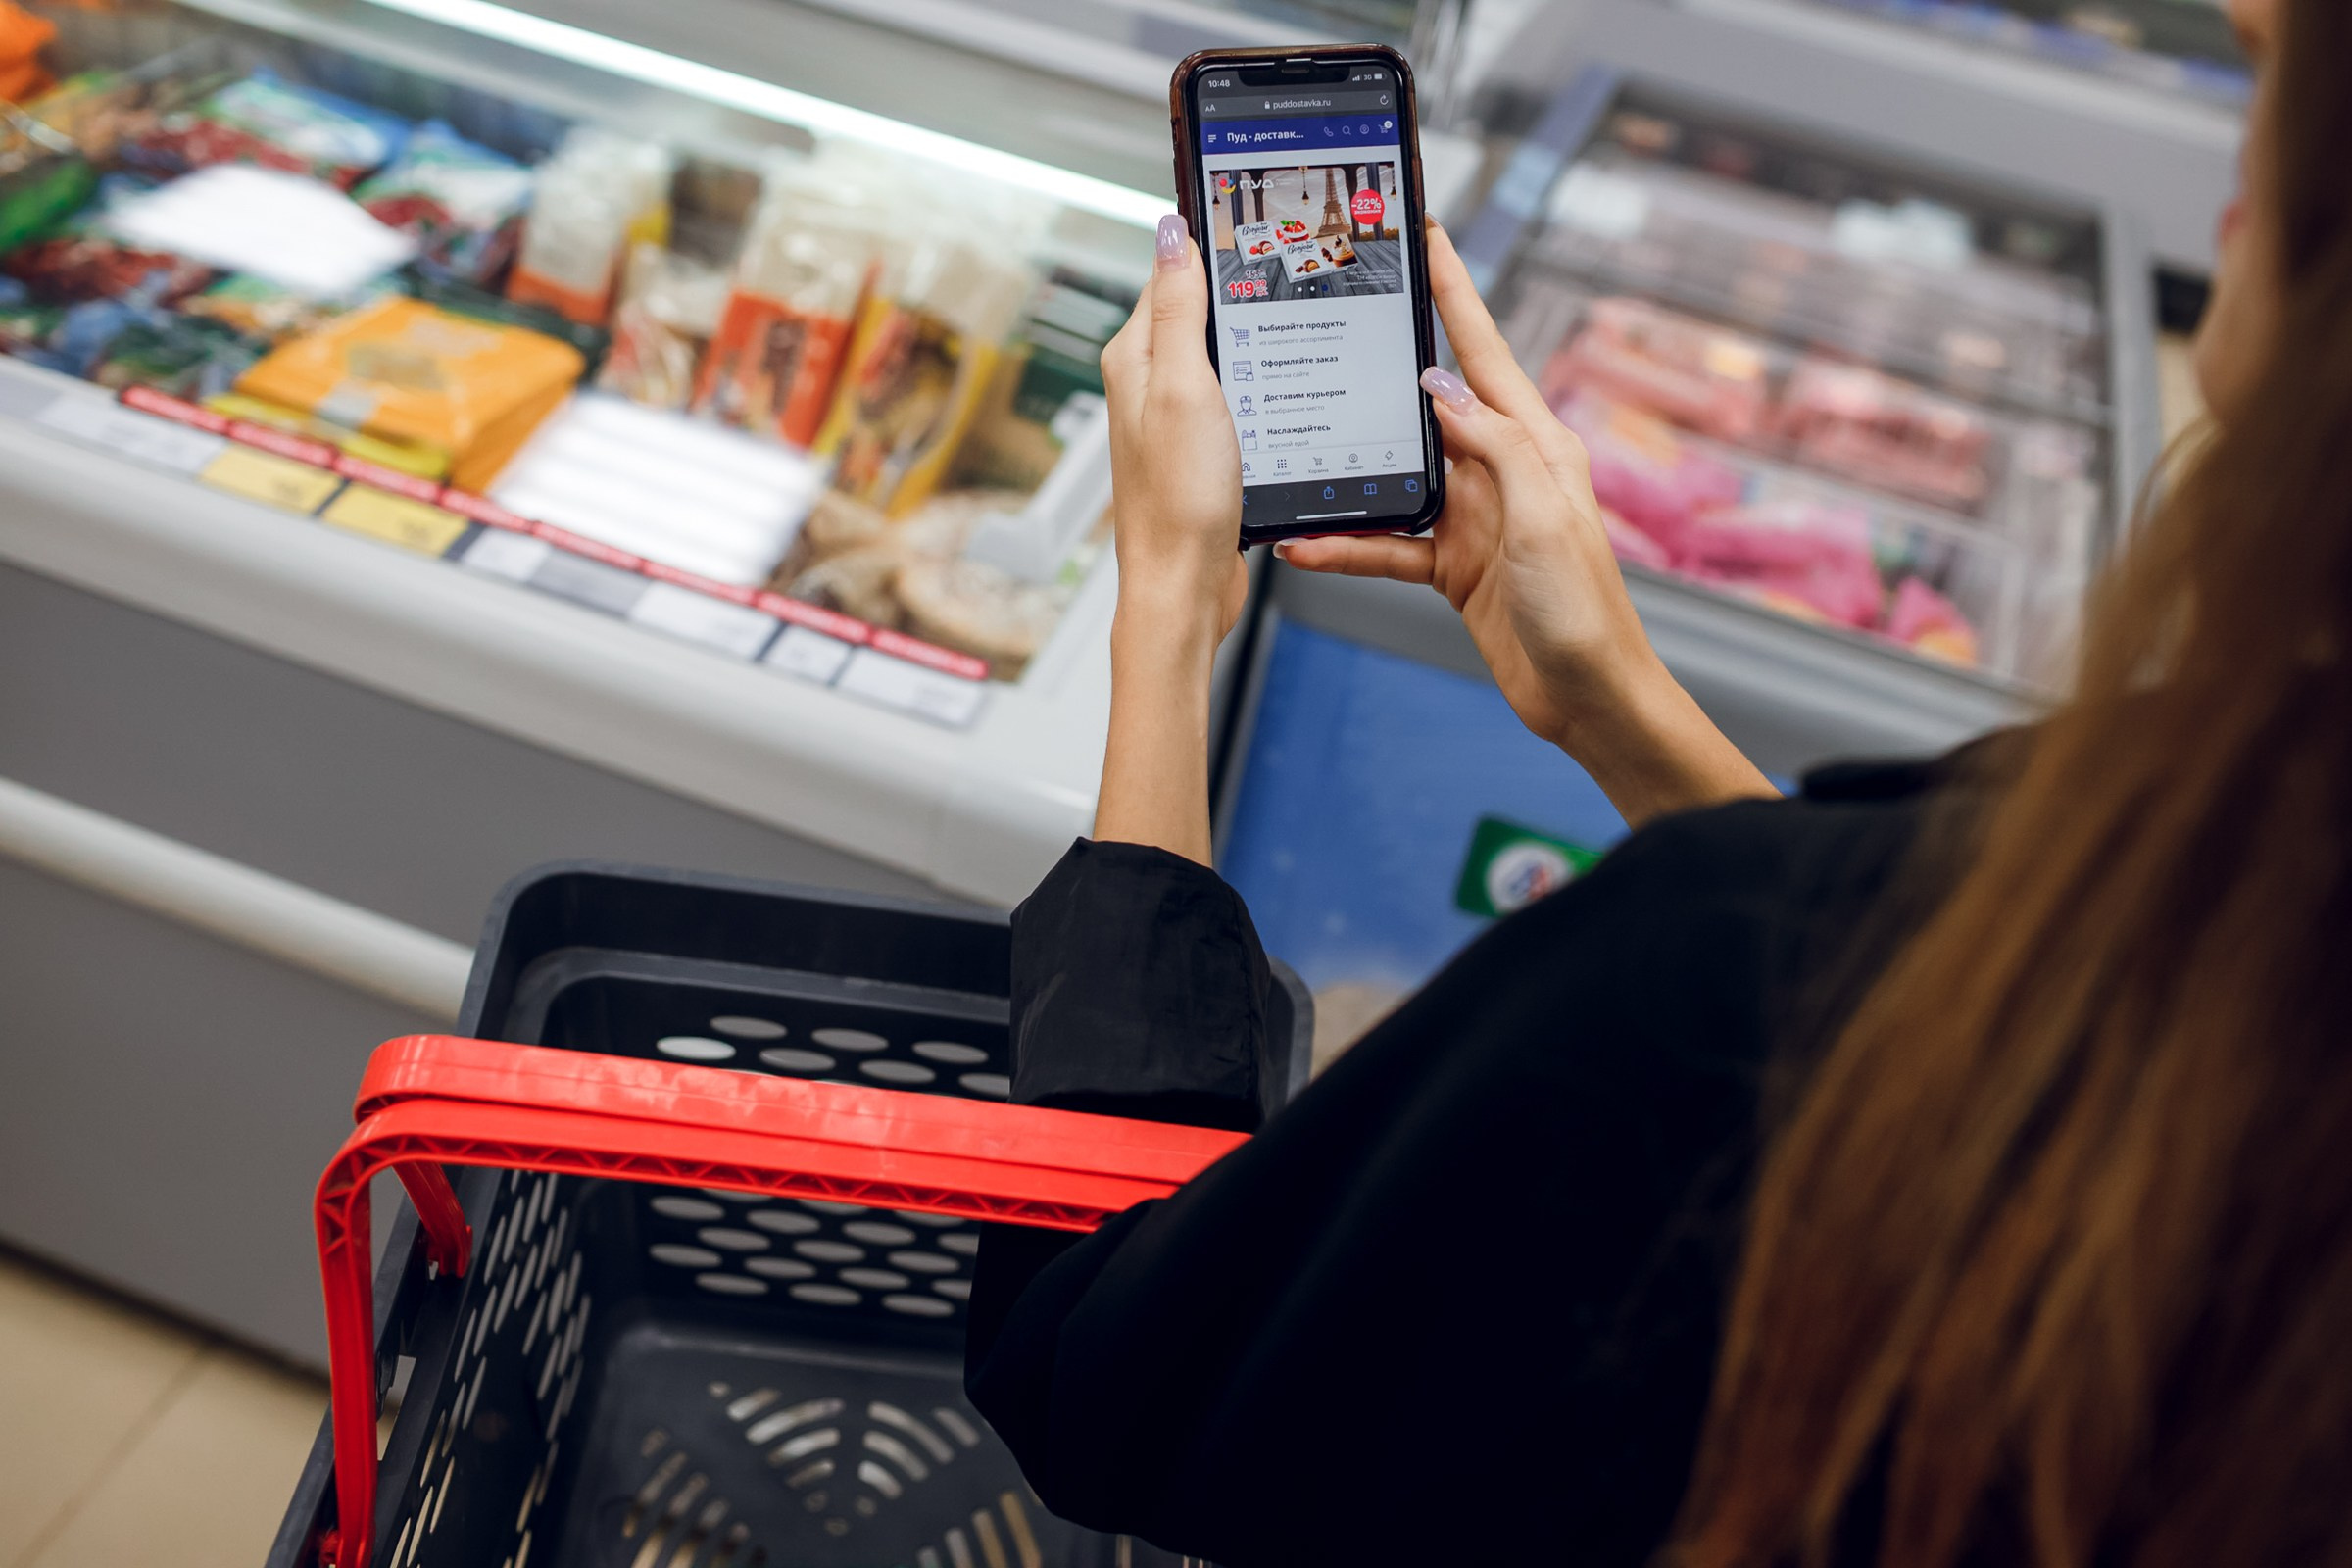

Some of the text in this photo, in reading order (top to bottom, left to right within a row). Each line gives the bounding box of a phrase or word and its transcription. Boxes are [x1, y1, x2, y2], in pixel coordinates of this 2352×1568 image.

[1208, 79, 1231, 88] 10:48
[1273, 99, 1331, 110] puddostavka.ru
[1227, 132, 1248, 144] Пуд
[1240, 179, 1274, 190] ПУД
[1351, 198, 1382, 210] -22%
[1228, 280, 1254, 298] 119
[1258, 321, 1347, 332] Выбирайте продукты
[1261, 357, 1313, 368] Оформляйте
[1264, 390, 1346, 403] Доставим курьером
[1270, 406, 1305, 415] выбранное
[1267, 425, 1331, 435] Наслаждайтесь
